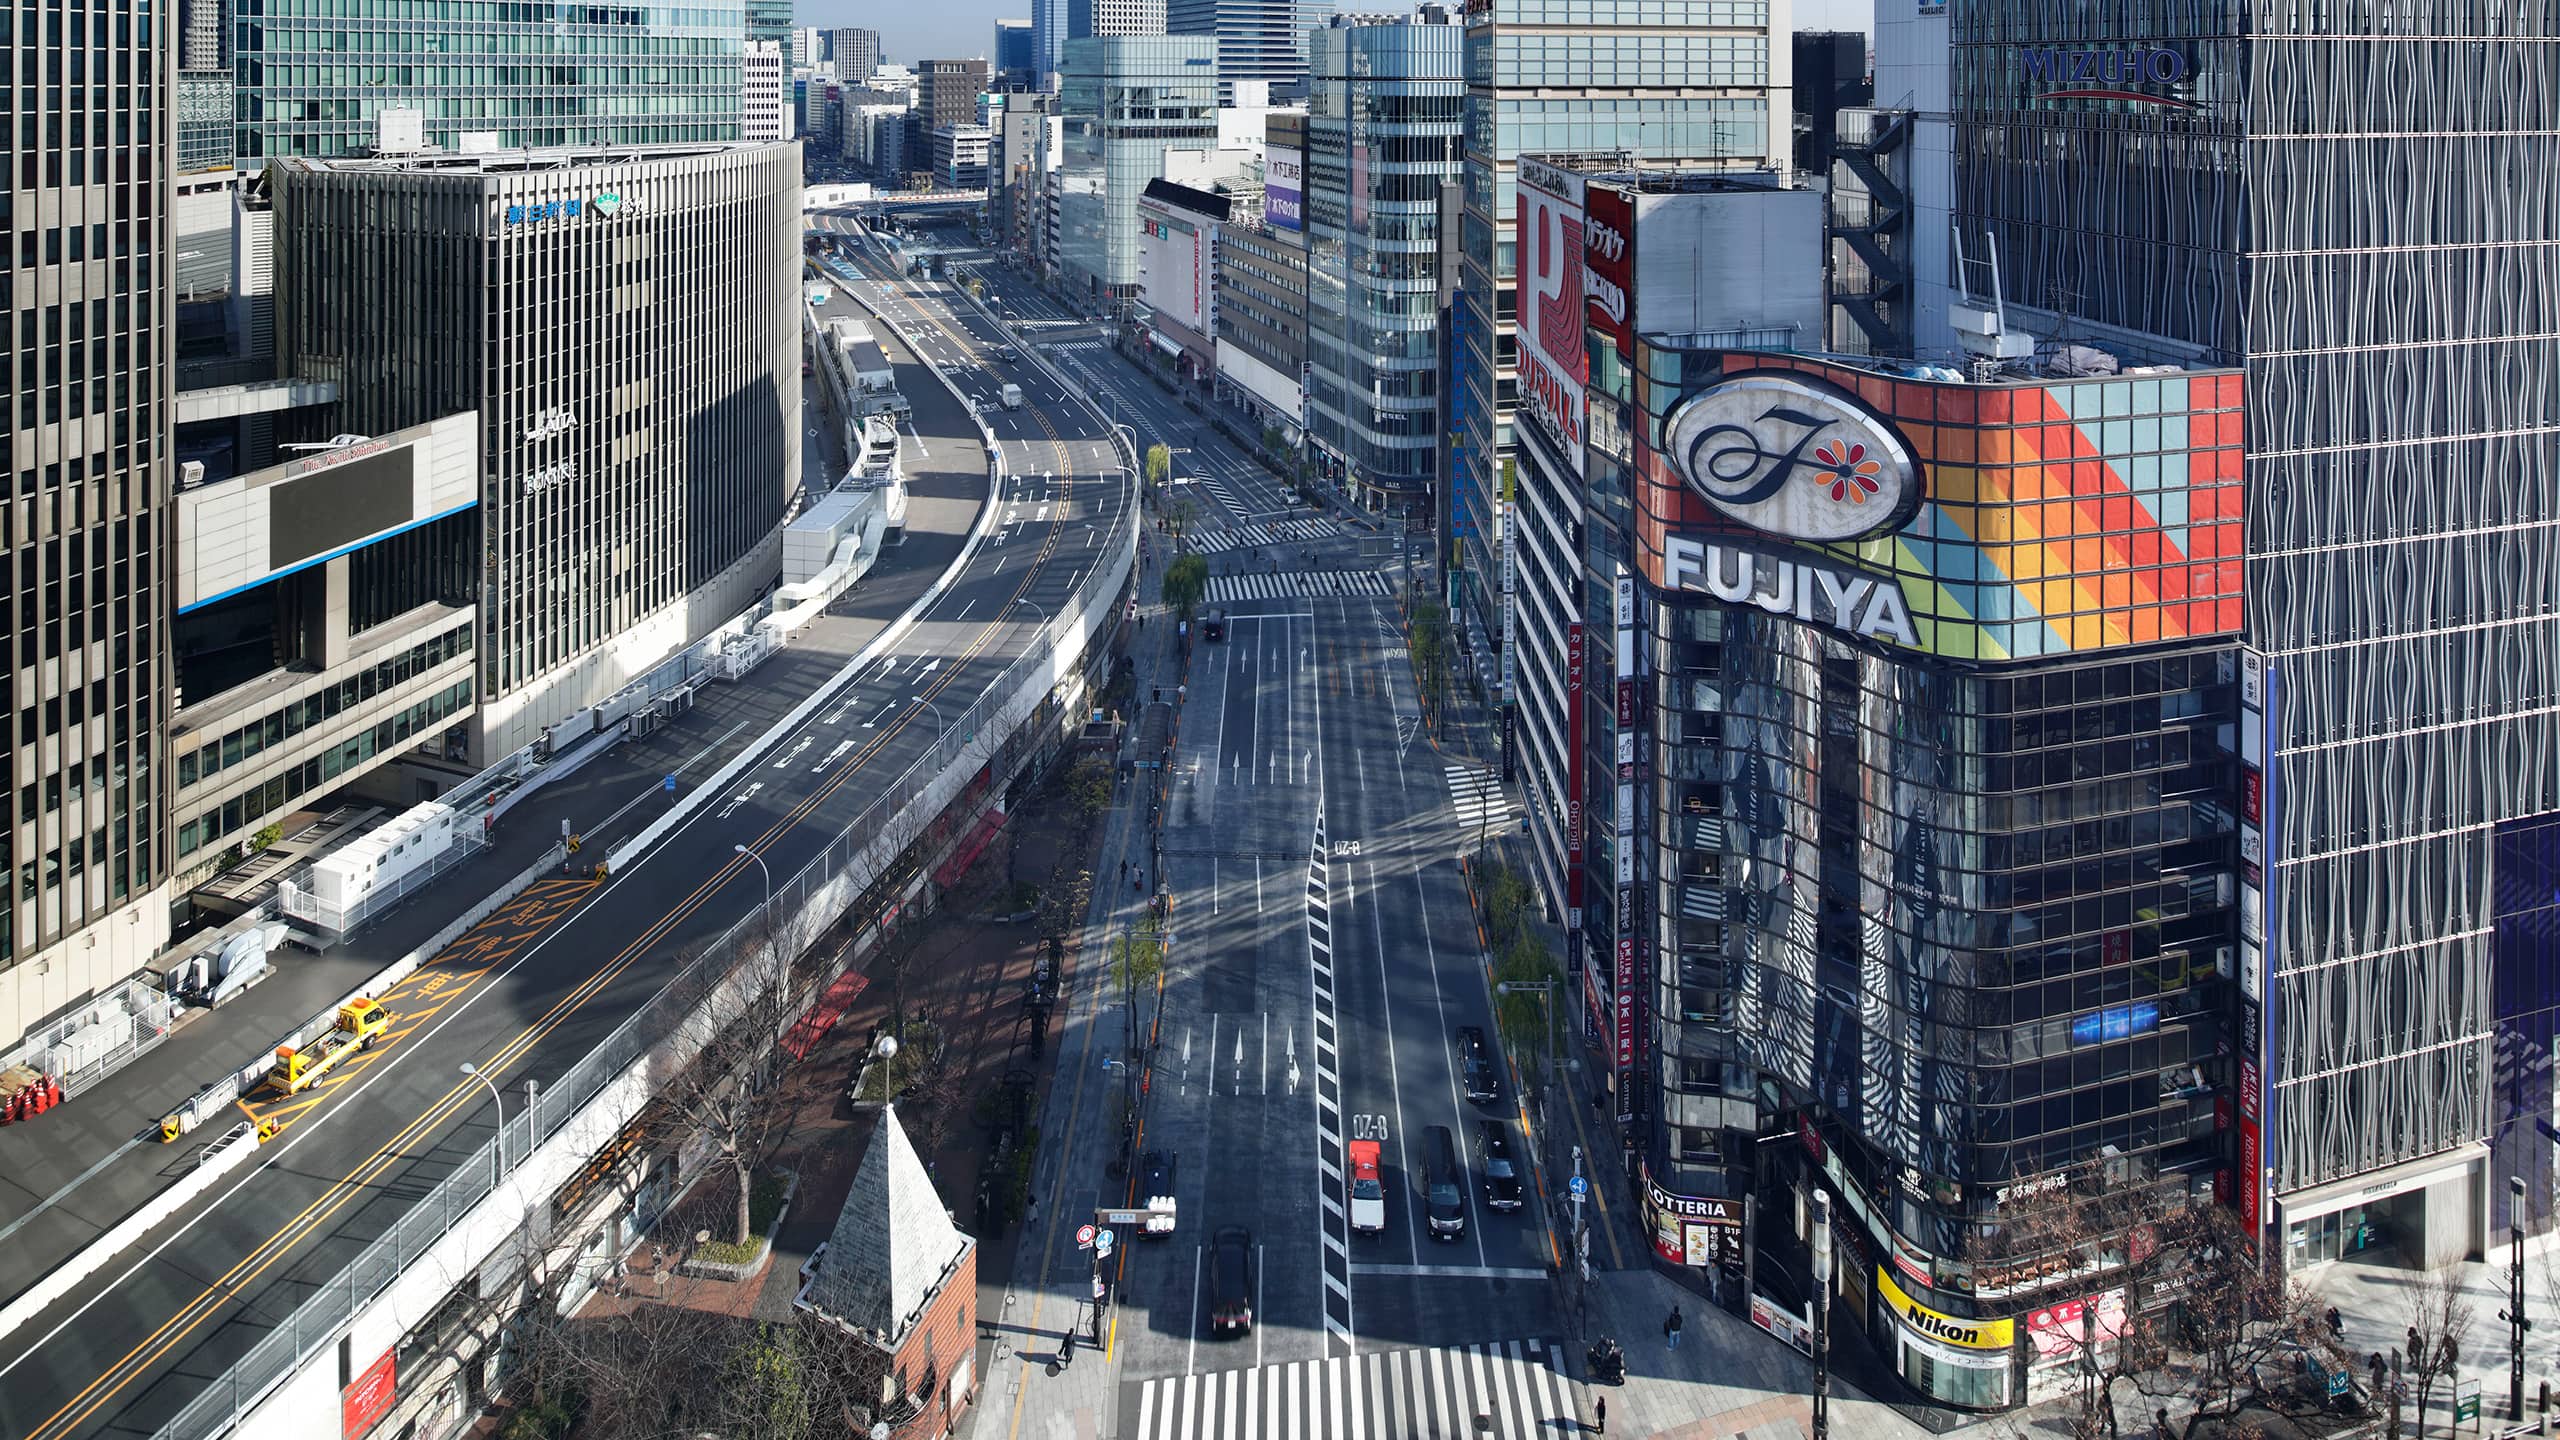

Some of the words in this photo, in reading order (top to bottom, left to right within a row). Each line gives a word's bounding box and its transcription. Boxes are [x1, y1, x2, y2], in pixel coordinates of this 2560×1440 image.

[1918, 6, 1946, 15] HULIC
[2019, 48, 2184, 84] MIZUHO
[508, 198, 580, 225] 朝日新聞
[1584, 216, 1624, 262] カラオケ
[1665, 532, 1922, 646] FUJIYA
[1570, 634, 1581, 691] カラオケ
[2245, 1134, 2255, 1176] REGAL
[1647, 1178, 1727, 1217] LOTTERIA
[2244, 1179, 2254, 1221] SHOES
[1907, 1304, 1979, 1344] Nikon
